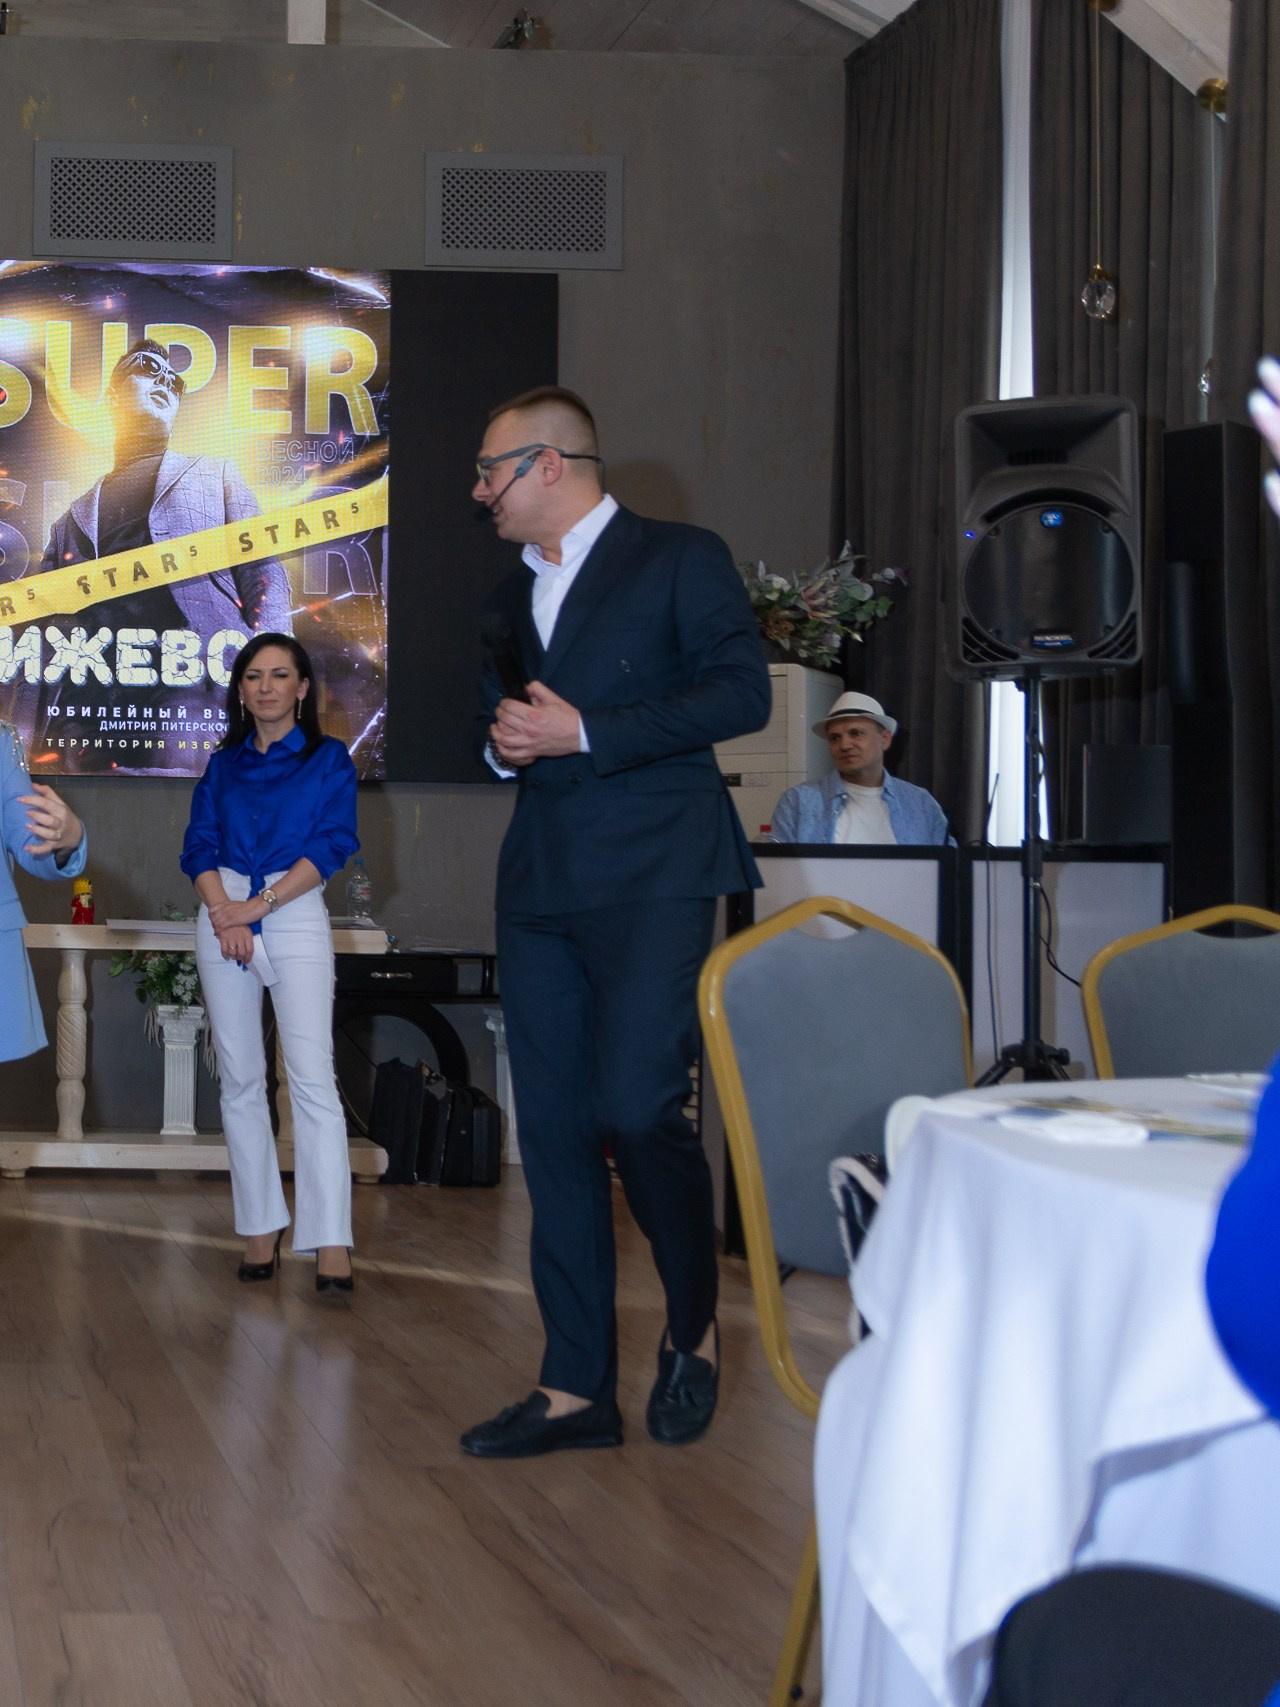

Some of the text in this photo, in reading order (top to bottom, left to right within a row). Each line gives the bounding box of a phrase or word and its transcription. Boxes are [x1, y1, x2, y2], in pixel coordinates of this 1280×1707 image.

[258, 437, 354, 463] ВЕСНОЙ
[258, 466, 307, 486] 2024
[46, 705, 187, 720] ЮБИЛЕЙНЫЙ
[99, 720, 157, 732] ДМИТРИЯ
[46, 738, 165, 750] ТЕРРИТОРИЯ
